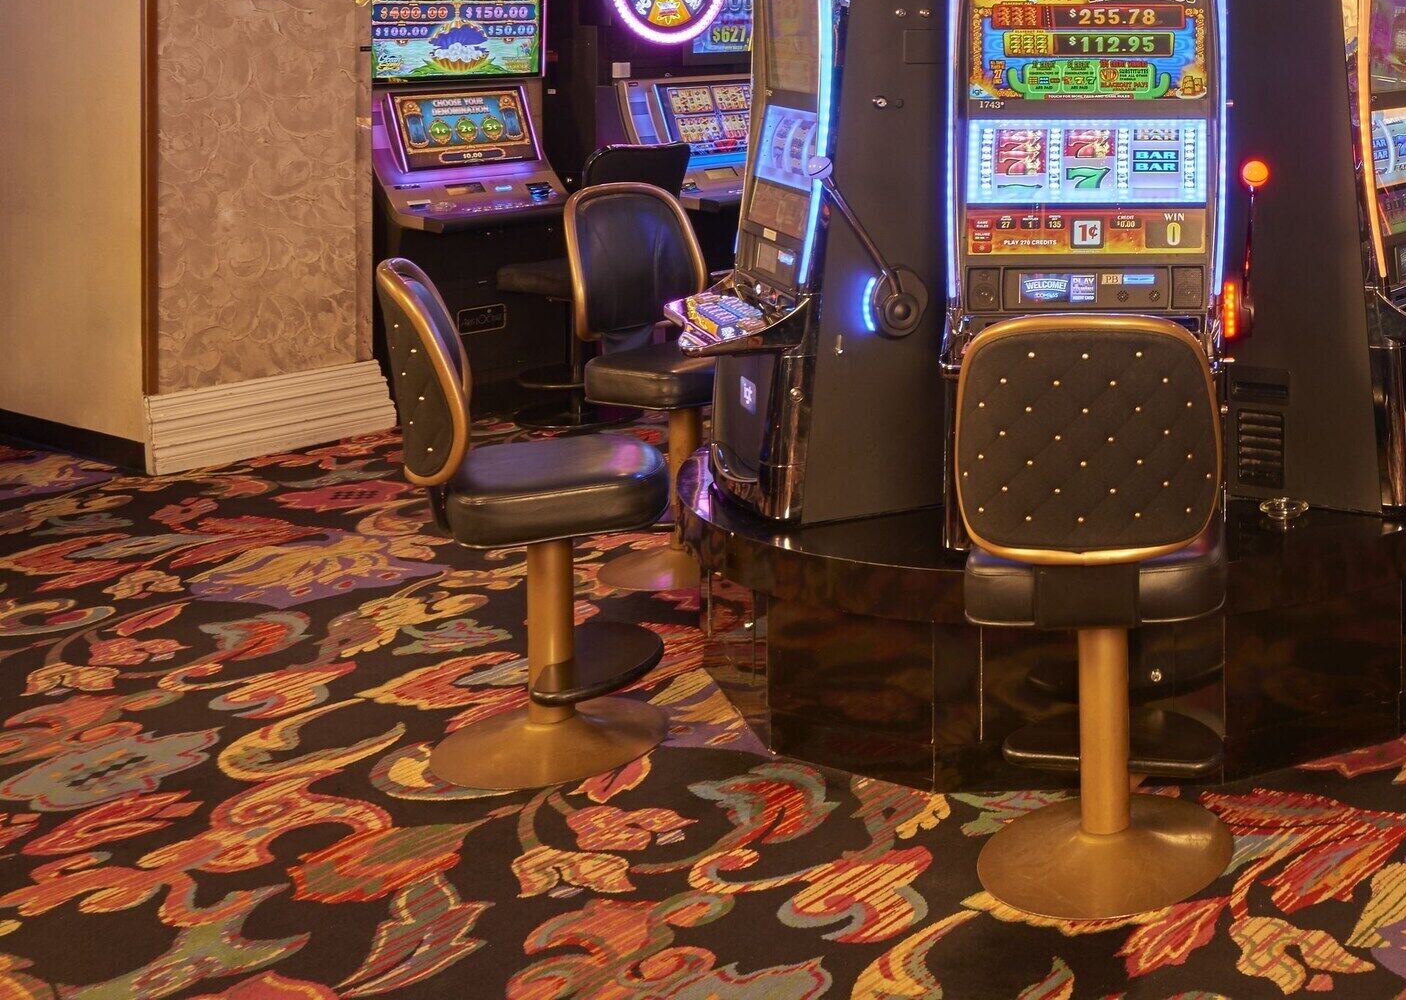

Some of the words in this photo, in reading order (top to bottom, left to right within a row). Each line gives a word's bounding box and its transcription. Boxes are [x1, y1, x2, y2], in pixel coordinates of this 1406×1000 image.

[380, 6, 448, 19] $400.00
[466, 6, 528, 18] $150.00
[1069, 8, 1156, 25] $255.78
[375, 26, 428, 36] $100.00
[488, 25, 534, 36] $50.00
[1069, 35, 1155, 53] $112.95
[432, 98, 458, 107] CHOOSE
[462, 97, 484, 106] YOUR
[432, 106, 491, 116] DENOMINATION
[1135, 151, 1177, 160] BAR
[1135, 162, 1177, 171] BAR
[1066, 167, 1111, 188] 7
[1164, 213, 1185, 221] WIN
[1078, 224, 1098, 242] 1¢
[1025, 280, 1067, 290] WELCOME!
